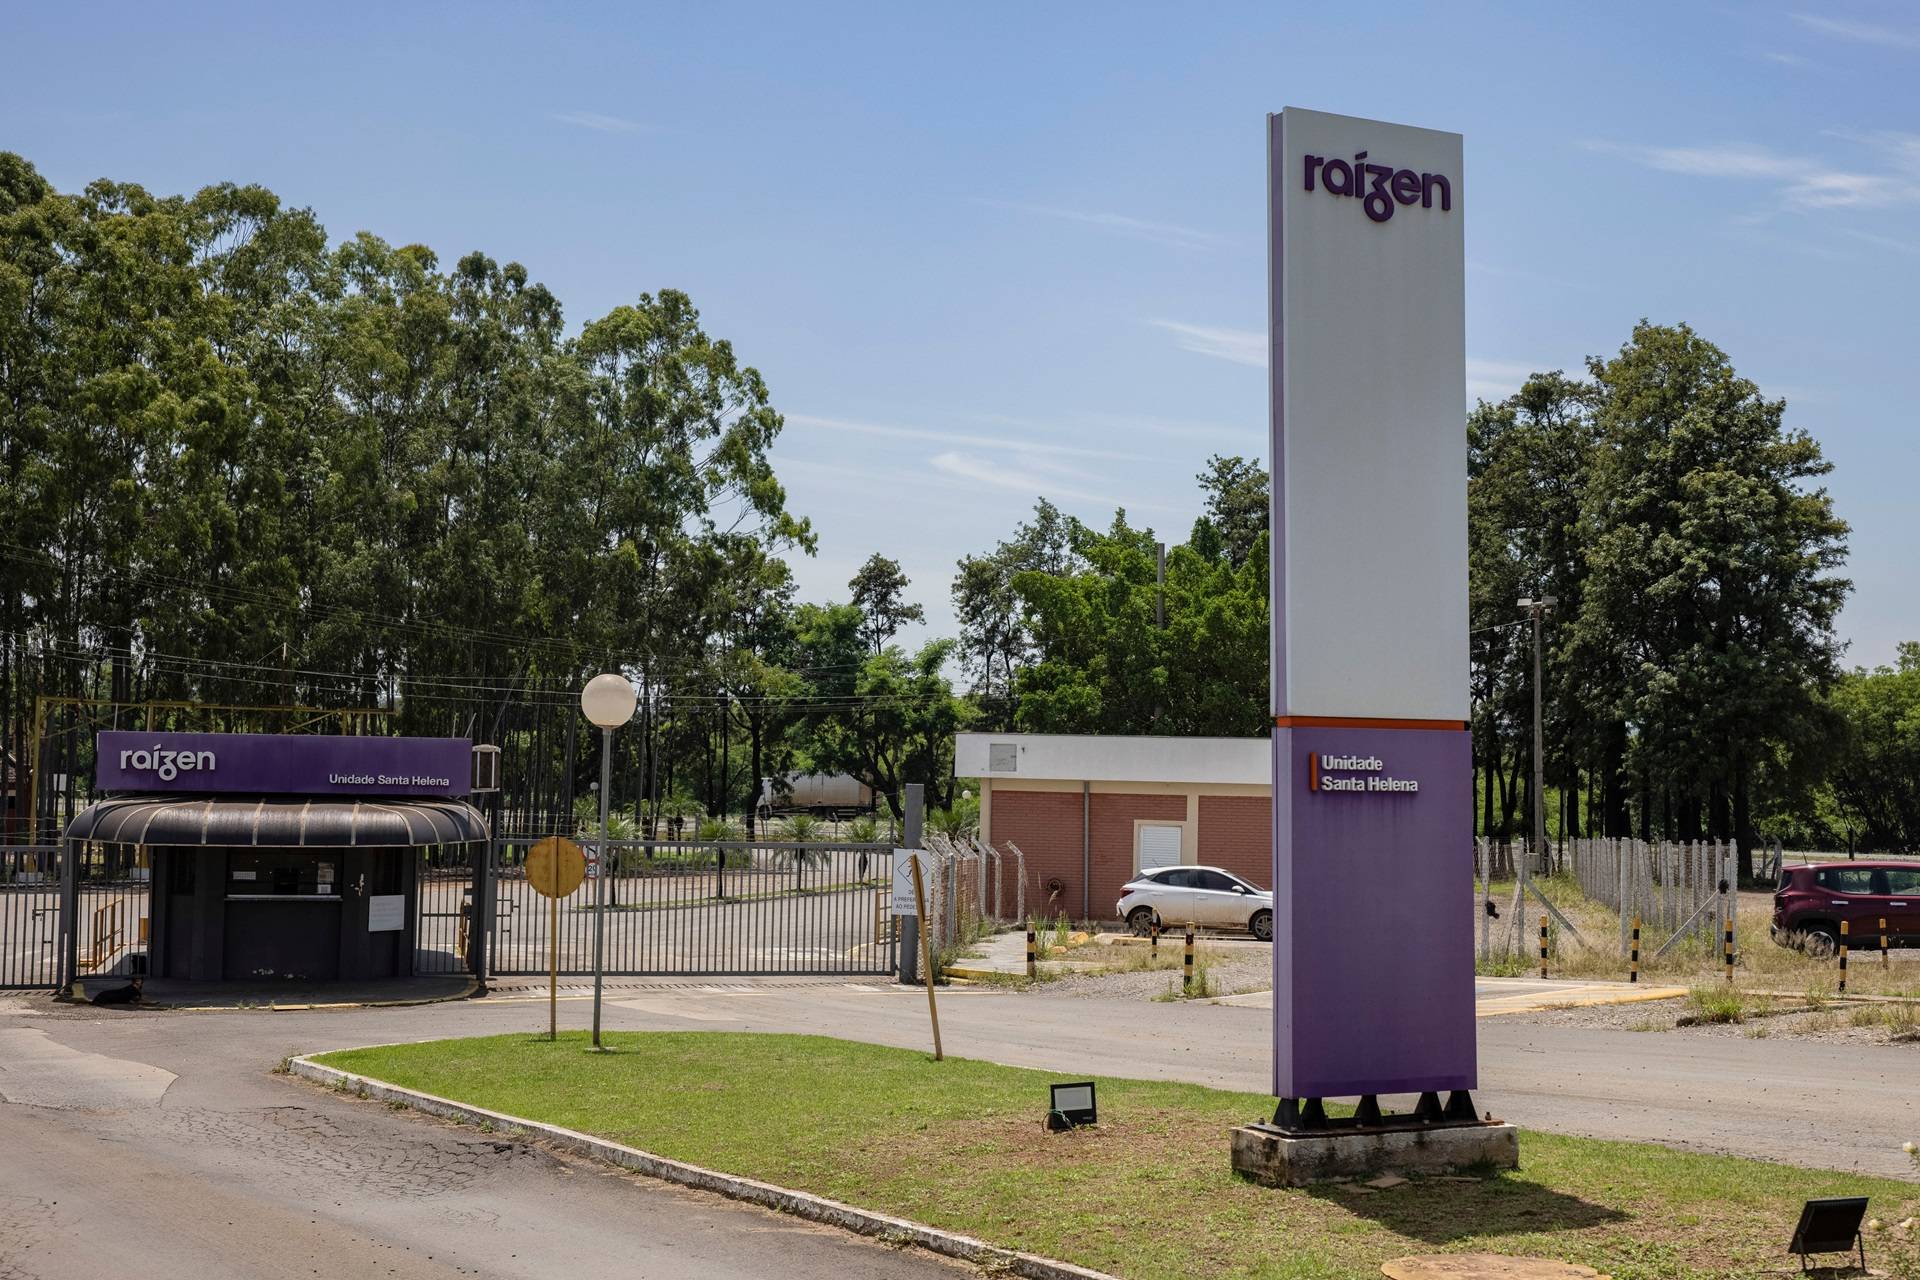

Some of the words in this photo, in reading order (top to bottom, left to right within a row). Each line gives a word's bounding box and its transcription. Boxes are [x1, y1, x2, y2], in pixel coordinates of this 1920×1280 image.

[1304, 150, 1452, 224] raízen
[120, 743, 216, 781] raízen
[1322, 754, 1383, 771] Unidade
[329, 773, 375, 786] Unidade
[377, 774, 410, 786] Santa
[412, 774, 450, 787] Helena
[1321, 775, 1365, 791] Santa
[1367, 776, 1418, 792] Helena
